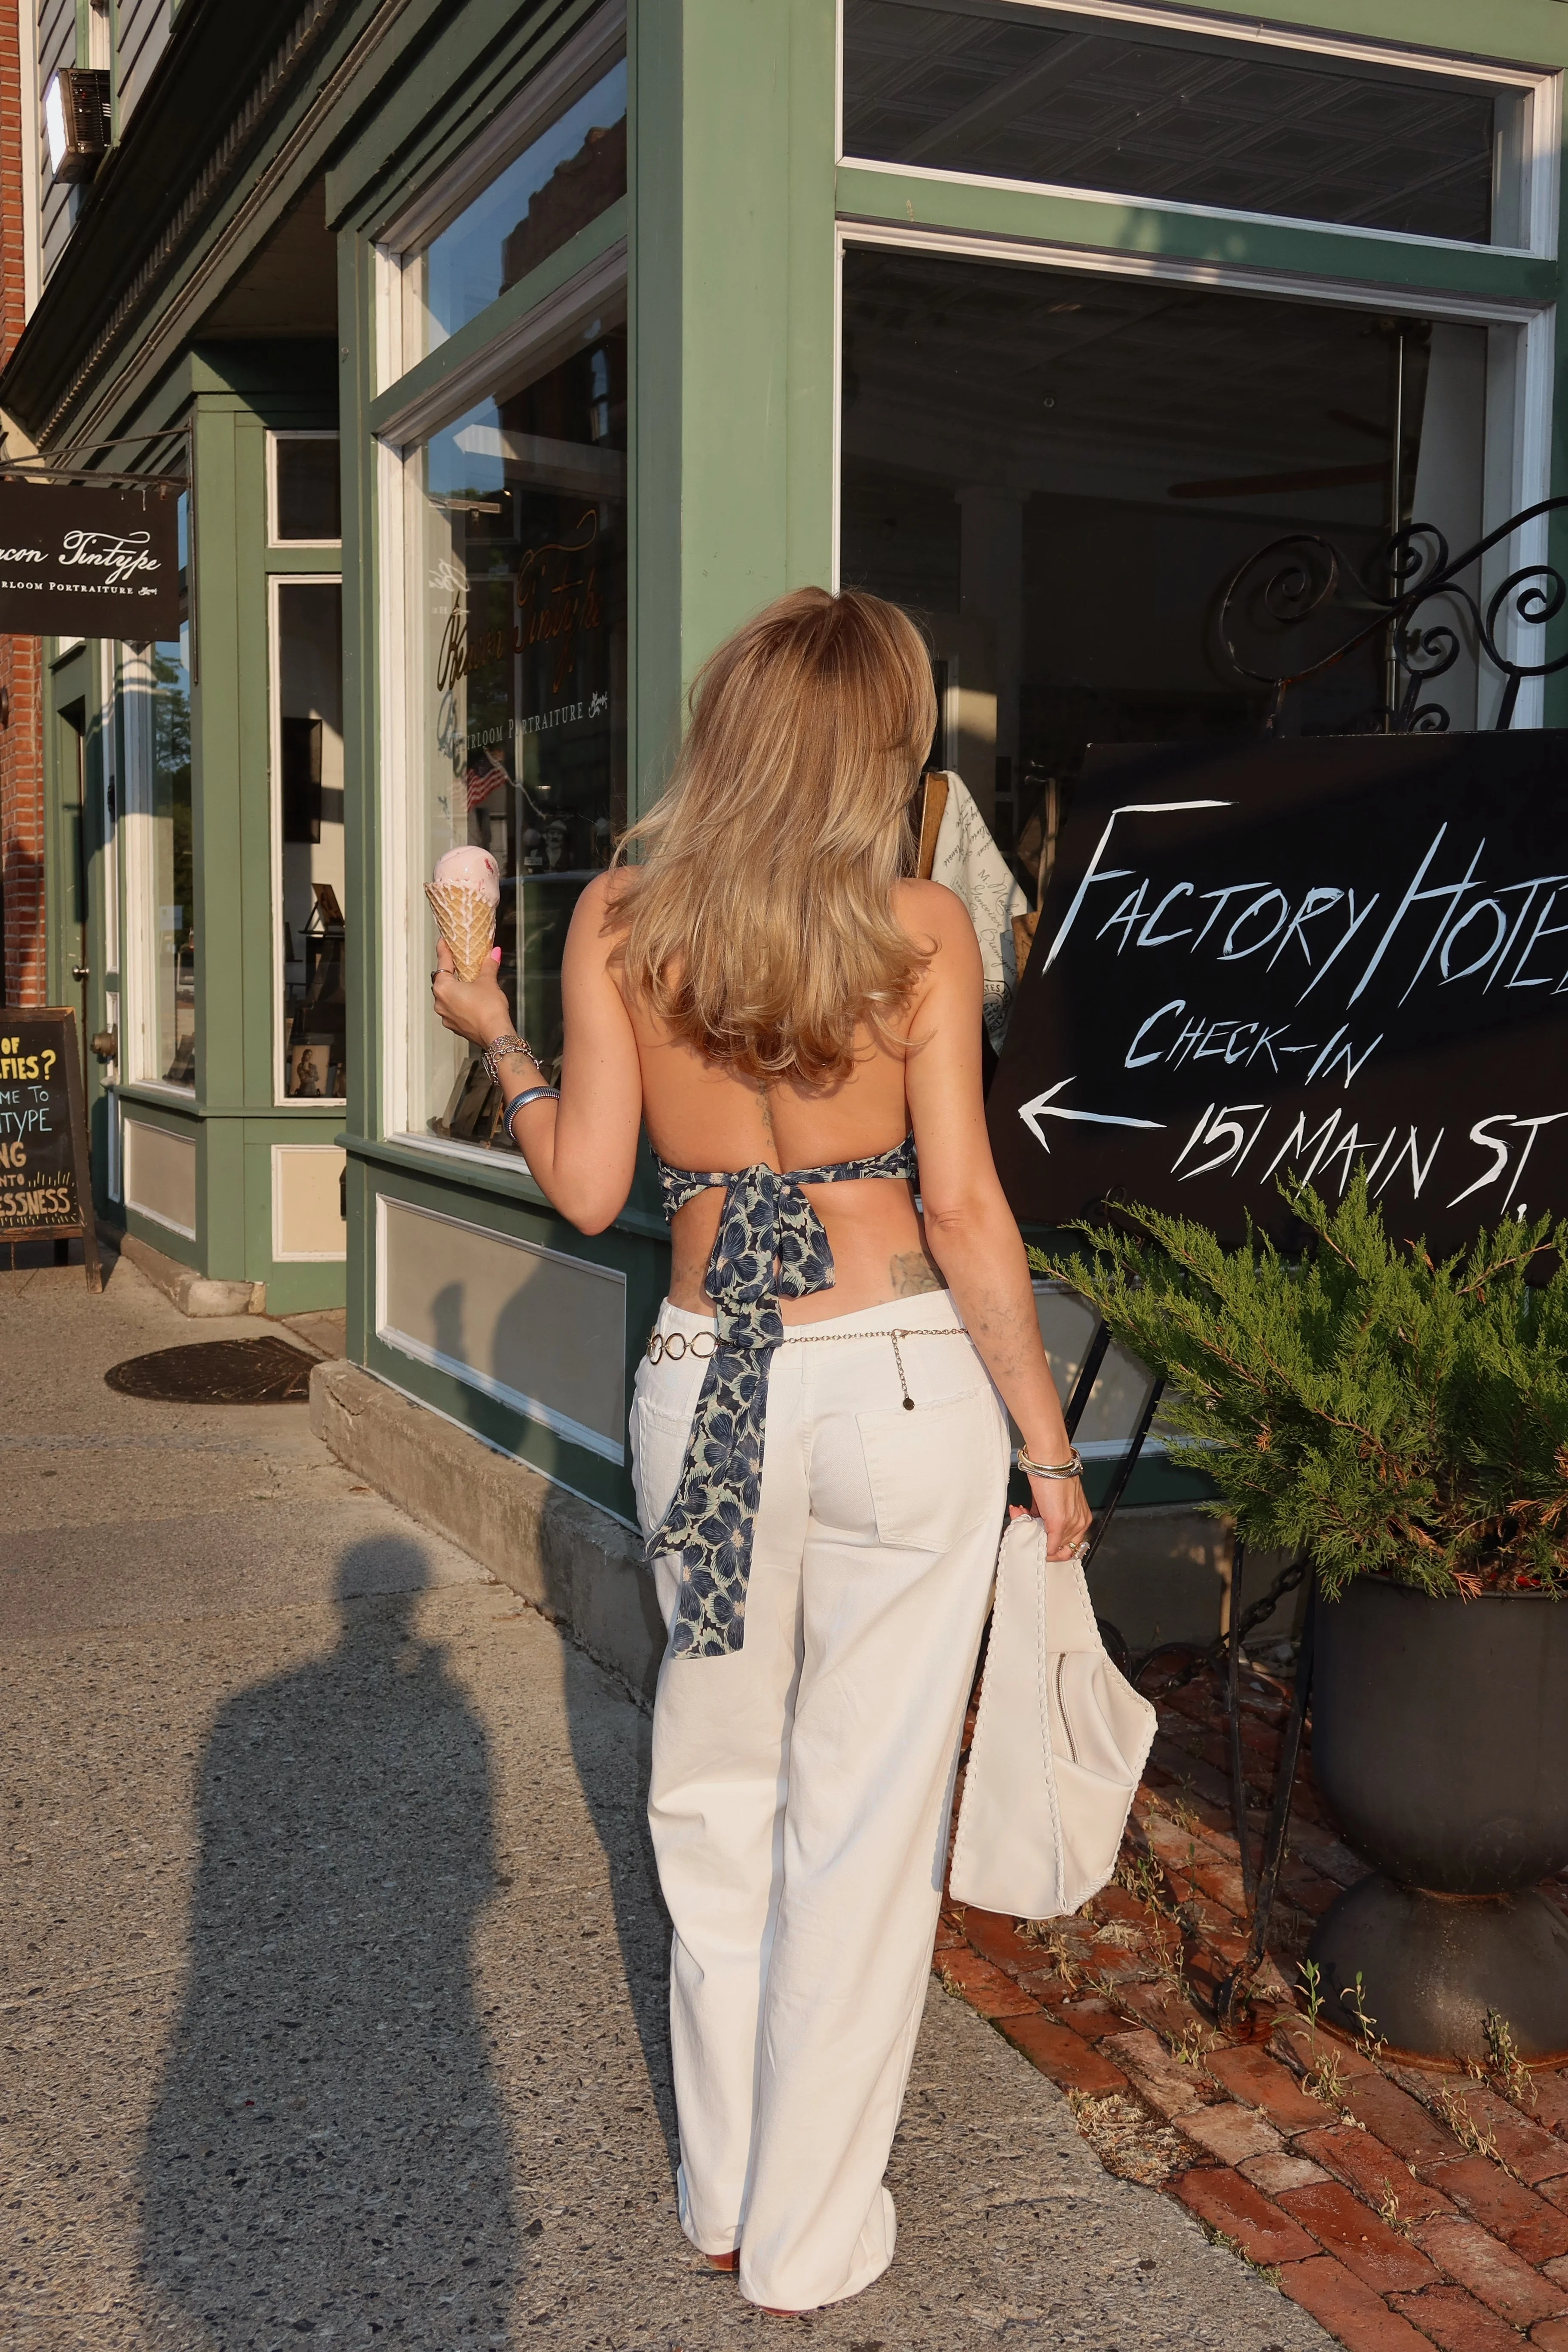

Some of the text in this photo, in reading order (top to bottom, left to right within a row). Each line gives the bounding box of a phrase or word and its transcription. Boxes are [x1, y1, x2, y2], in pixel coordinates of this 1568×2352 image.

[58, 530, 162, 585] Tintype
[49, 582, 134, 595] PORTRAITURE
[1041, 799, 1379, 1008] FACTORY
[0, 1049, 56, 1080] FIES?
[1, 1037, 20, 1055] OF
[1124, 999, 1383, 1089] CHECK-IN
[28, 1085, 49, 1103] TO
[1170, 1102, 1272, 1182] 151
[1260, 1106, 1444, 1200] MAIN
